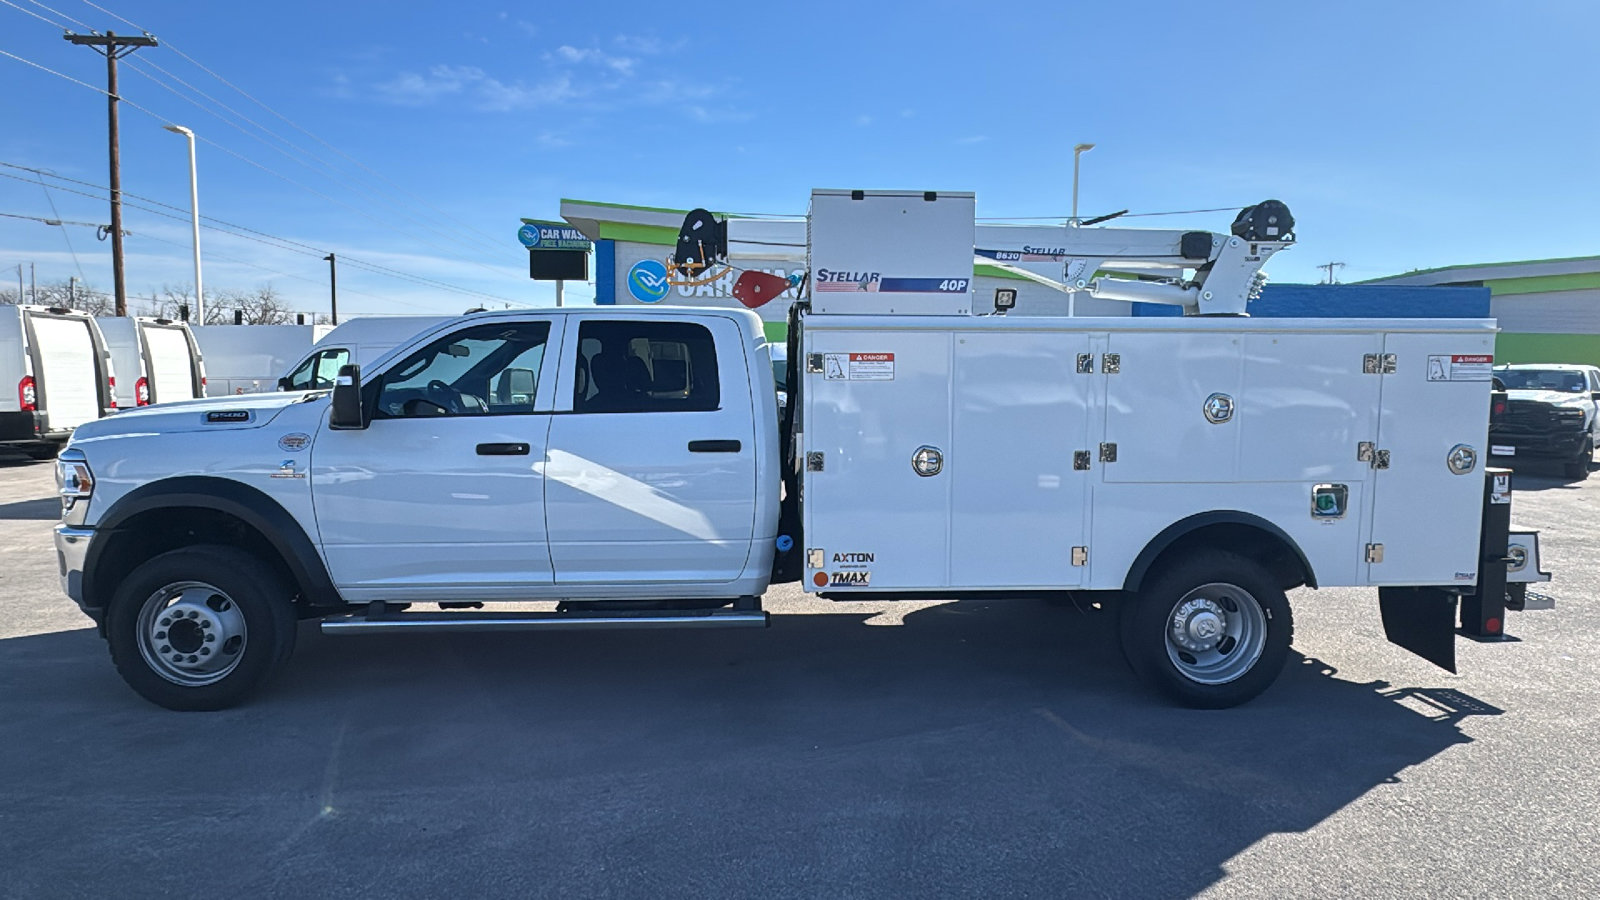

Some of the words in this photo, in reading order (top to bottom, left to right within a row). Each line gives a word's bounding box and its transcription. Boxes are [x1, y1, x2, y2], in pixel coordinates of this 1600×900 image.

[541, 229, 560, 240] CAR
[561, 229, 588, 240] WAS
[1023, 245, 1066, 255] STELLAR
[816, 268, 880, 283] STELLAR
[939, 280, 967, 291] 40P
[832, 553, 875, 563] AXTON
[830, 571, 868, 583] TMAX
